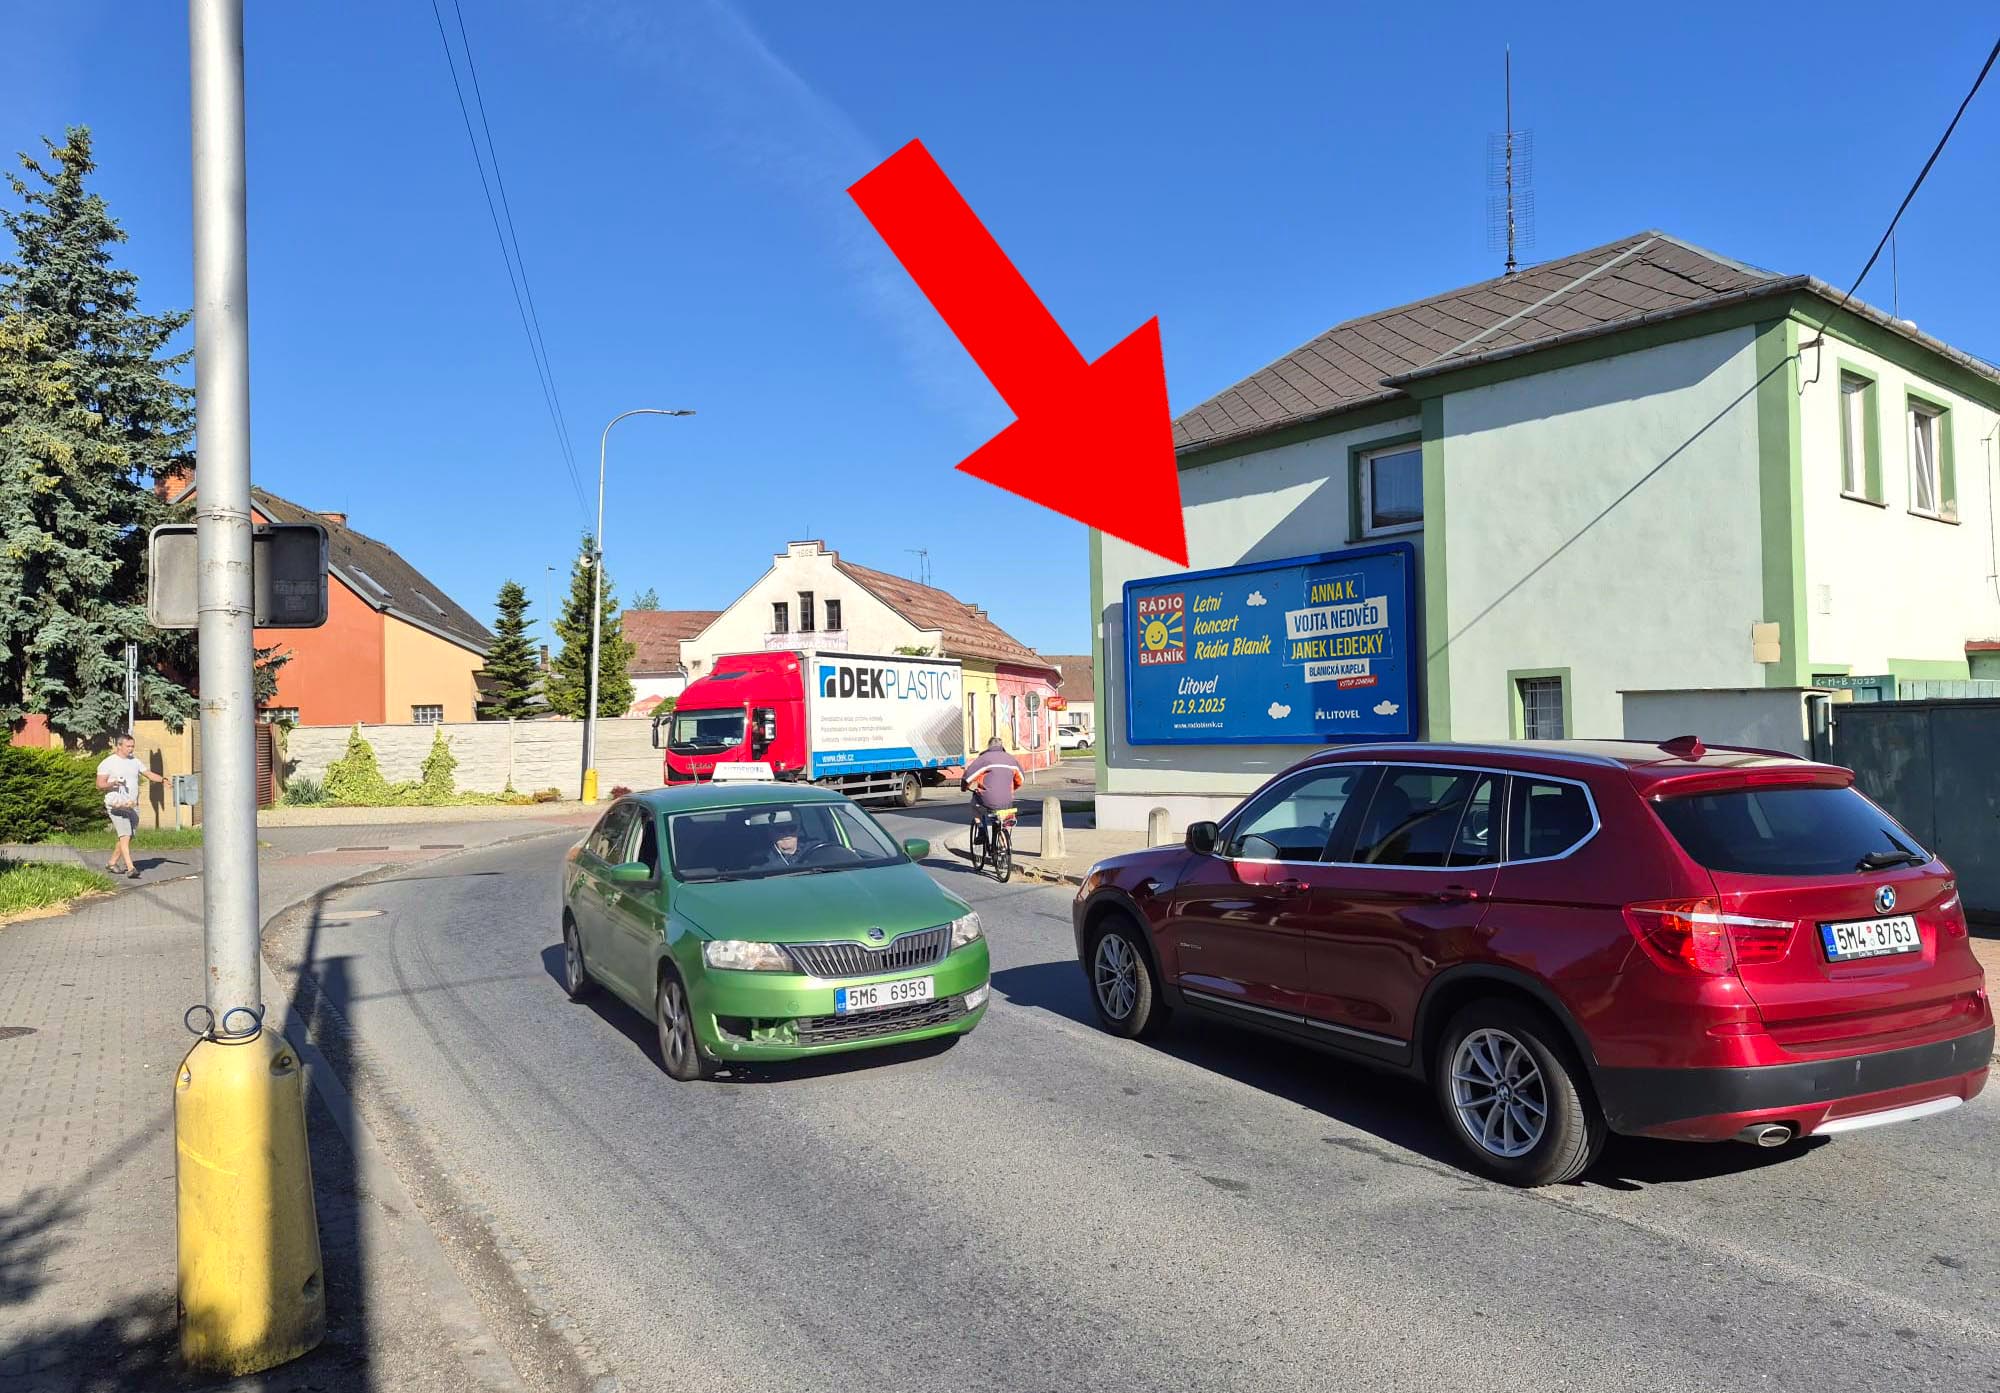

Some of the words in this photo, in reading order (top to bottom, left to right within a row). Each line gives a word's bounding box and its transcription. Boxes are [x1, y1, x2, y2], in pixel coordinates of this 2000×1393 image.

[1311, 582, 1343, 604] ANNA
[1346, 580, 1358, 599] K.
[1139, 597, 1183, 613] RÁDIO
[1193, 615, 1240, 635] koncert
[1294, 611, 1328, 633] VOJTA
[1330, 602, 1379, 630] NEDVĚD
[1194, 640, 1230, 660] Rádia
[1290, 640, 1327, 660] JANEK
[1330, 630, 1383, 657] LEDECKÝ
[1141, 649, 1184, 664] BLANÍK
[1340, 664, 1366, 675] KAPELA
[839, 666, 951, 700] DEKPLASTIC
[1178, 674, 1219, 695] Litovel
[1326, 710, 1360, 720] LITOVEL
[822, 753, 855, 763] www.dek.cz
[1837, 926, 1866, 950] 5M4
[1875, 921, 1911, 945] 8763
[849, 988, 878, 1006] 5M6
[890, 980, 926, 1000] 6959
